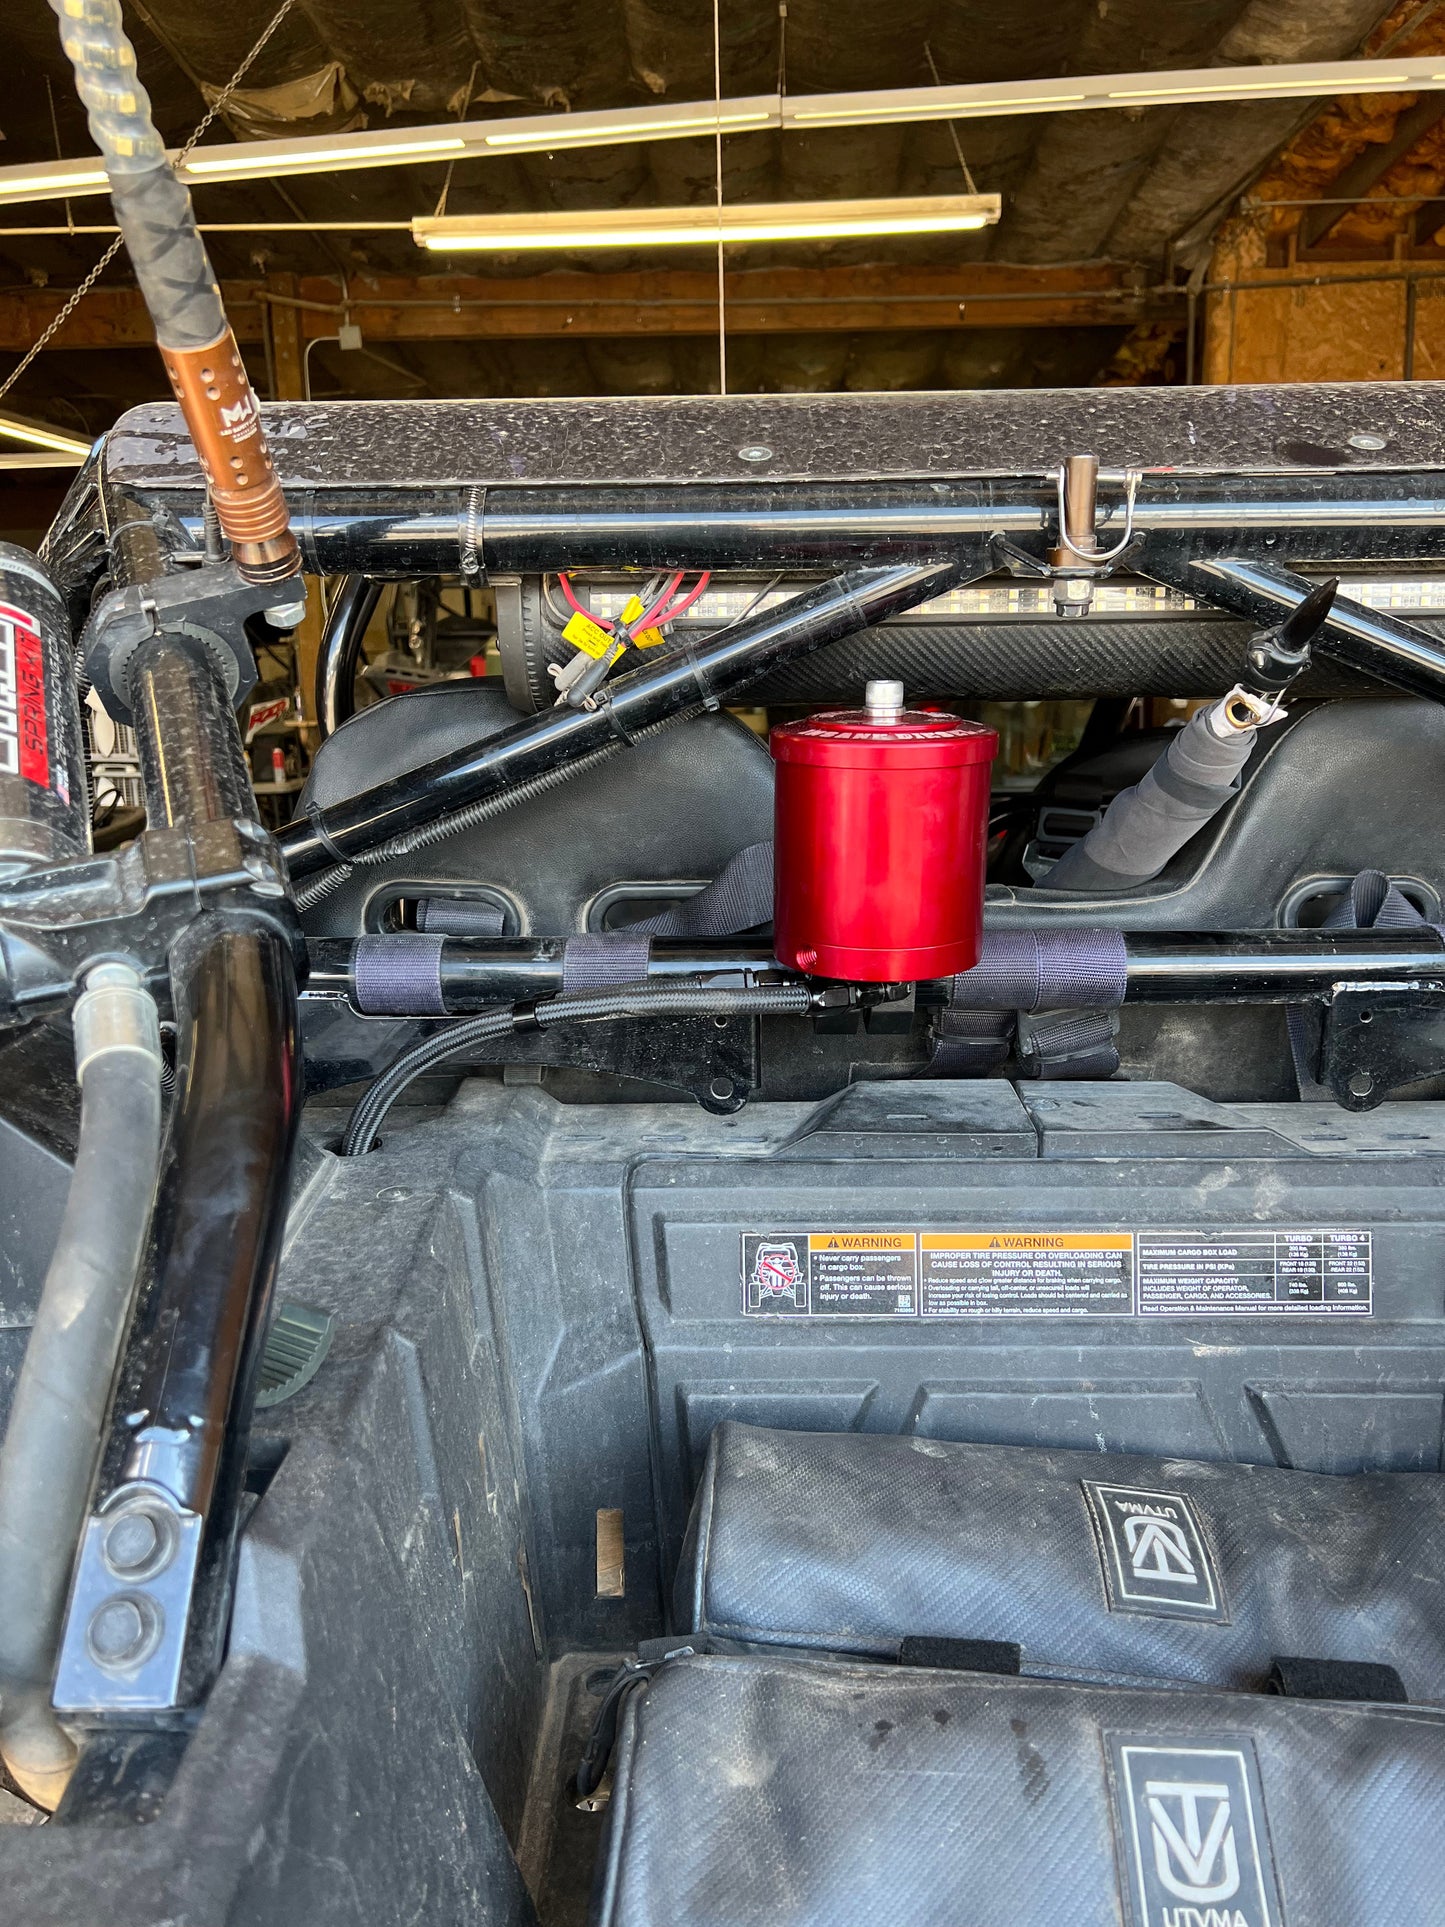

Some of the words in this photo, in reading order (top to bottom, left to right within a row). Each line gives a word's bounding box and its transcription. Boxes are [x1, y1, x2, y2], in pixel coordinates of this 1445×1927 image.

[585, 623, 600, 635] ACC
[599, 632, 612, 644] OUT
[20, 631, 39, 667] KIT
[22, 670, 44, 755] SPRING
[842, 1238, 902, 1247] WARNING
[1003, 1238, 1064, 1247] WARNING
[841, 1255, 859, 1263] carry
[860, 1255, 901, 1263] passengers
[819, 1275, 860, 1283] Passengers
[820, 1293, 841, 1301] injury
[1114, 1501, 1178, 1519] UTVMA
